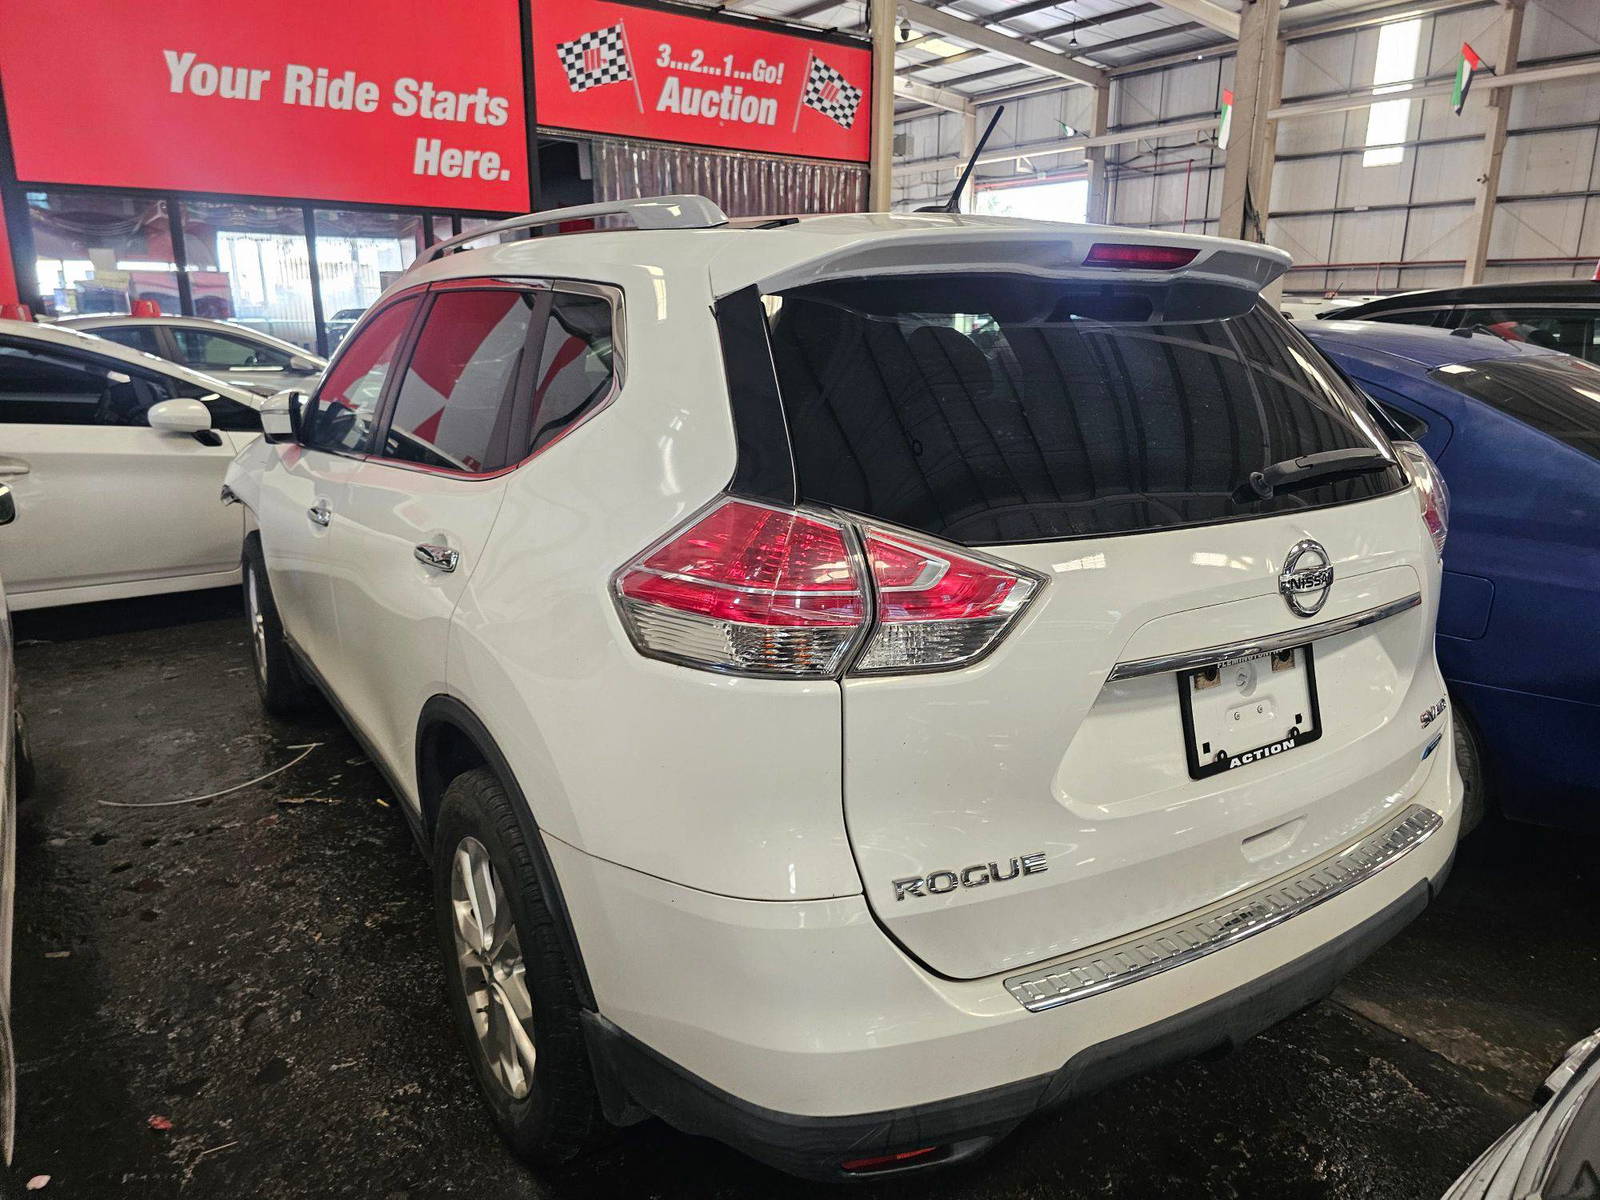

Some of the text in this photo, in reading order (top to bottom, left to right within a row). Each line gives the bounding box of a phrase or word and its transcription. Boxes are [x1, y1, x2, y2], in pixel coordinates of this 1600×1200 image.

[163, 50, 509, 126] Your Ride Starts
[656, 76, 778, 125] Auction
[413, 138, 511, 182] Here.
[1229, 739, 1295, 769] ACTION
[892, 851, 1049, 902] ROGUE
